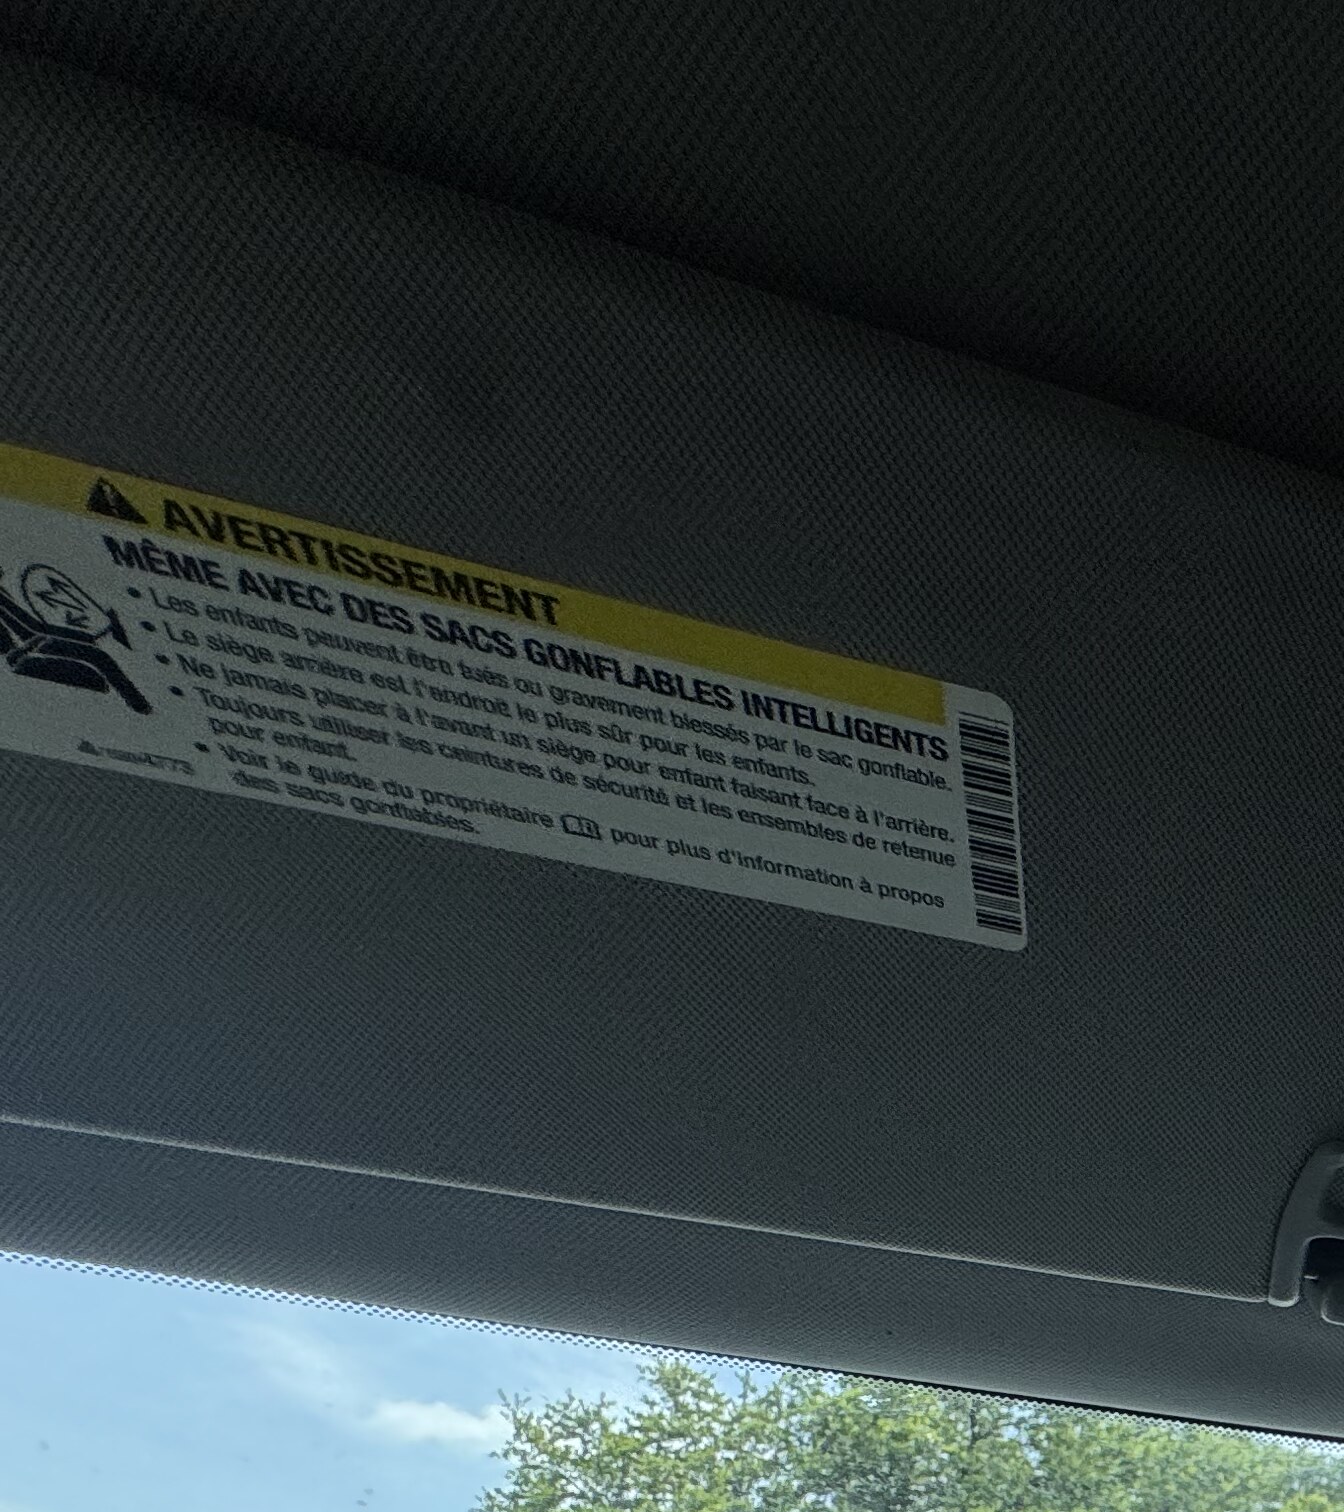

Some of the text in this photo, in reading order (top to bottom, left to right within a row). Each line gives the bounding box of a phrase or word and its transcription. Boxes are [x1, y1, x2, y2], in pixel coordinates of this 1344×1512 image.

[163, 498, 561, 626] AVERTISSEMENT
[101, 534, 950, 763] MÊME AVEC DES SACS GONFLABLES INTELLIGENTS
[147, 586, 201, 618] Les
[204, 604, 300, 641] enfants
[669, 709, 750, 746] blessés
[753, 732, 787, 753] par
[793, 738, 814, 760] le
[816, 748, 853, 770] sac
[857, 757, 953, 792] gonflable.
[162, 620, 200, 648] Le
[515, 702, 538, 724] le
[638, 733, 690, 758] pour
[175, 652, 217, 680] Ne
[535, 736, 598, 765] siège
[601, 752, 651, 775] pour
[657, 765, 727, 793] enfant
[805, 793, 850, 820] face
[855, 804, 869, 824] à
[872, 809, 955, 844] l'arrière.
[193, 685, 306, 728] Toujours
[548, 765, 579, 786] de
[700, 796, 734, 820] les
[736, 808, 848, 844] ensembles
[851, 831, 878, 850] de
[881, 839, 957, 868] retenue
[207, 716, 265, 743] pour
[381, 779, 415, 800] du
[609, 827, 660, 850] pour
[665, 838, 712, 861] plus
[717, 847, 855, 889] d'information
[859, 876, 873, 893] à
[877, 883, 945, 909] propos
